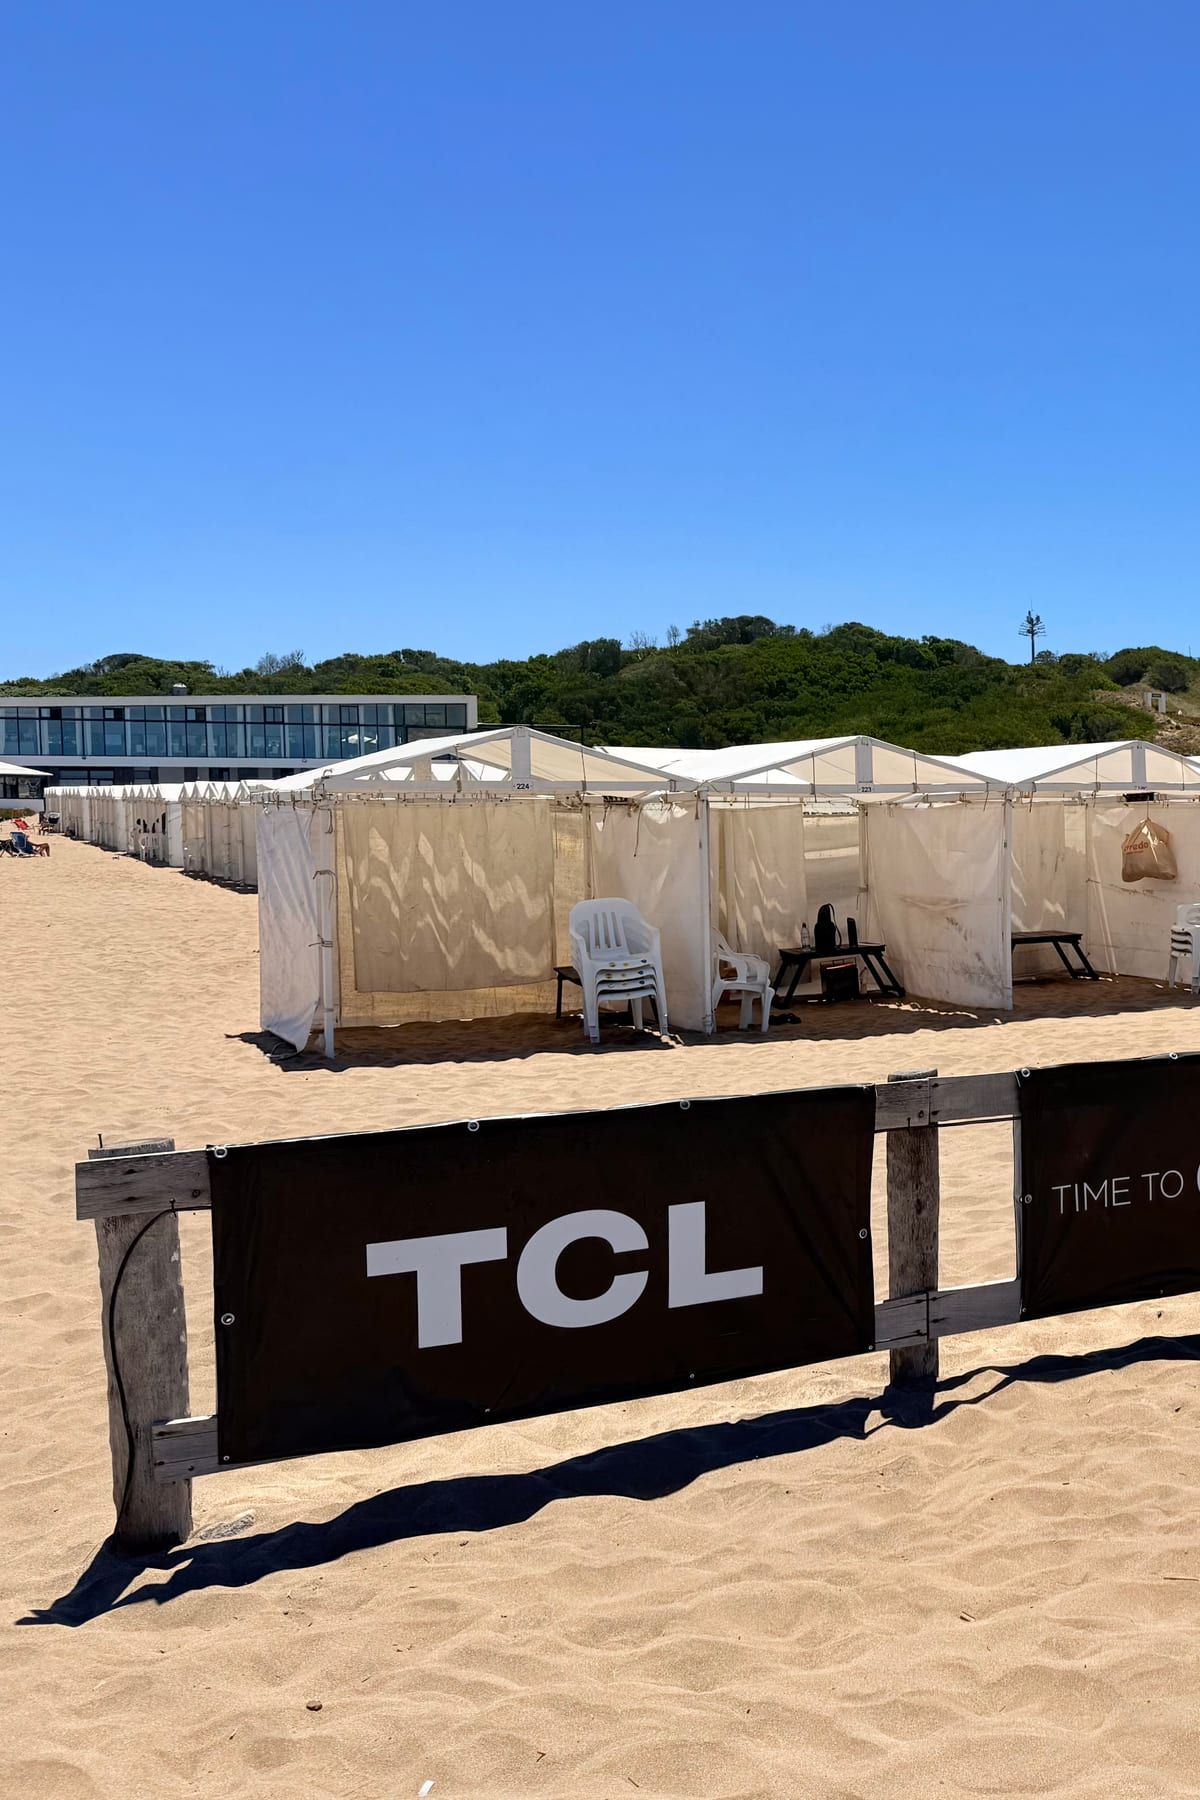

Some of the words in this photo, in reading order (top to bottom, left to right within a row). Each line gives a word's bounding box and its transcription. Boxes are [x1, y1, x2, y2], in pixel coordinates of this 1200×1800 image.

[1051, 1176, 1132, 1214] TIME
[1141, 1170, 1184, 1201] TO
[366, 1201, 763, 1348] TCL
